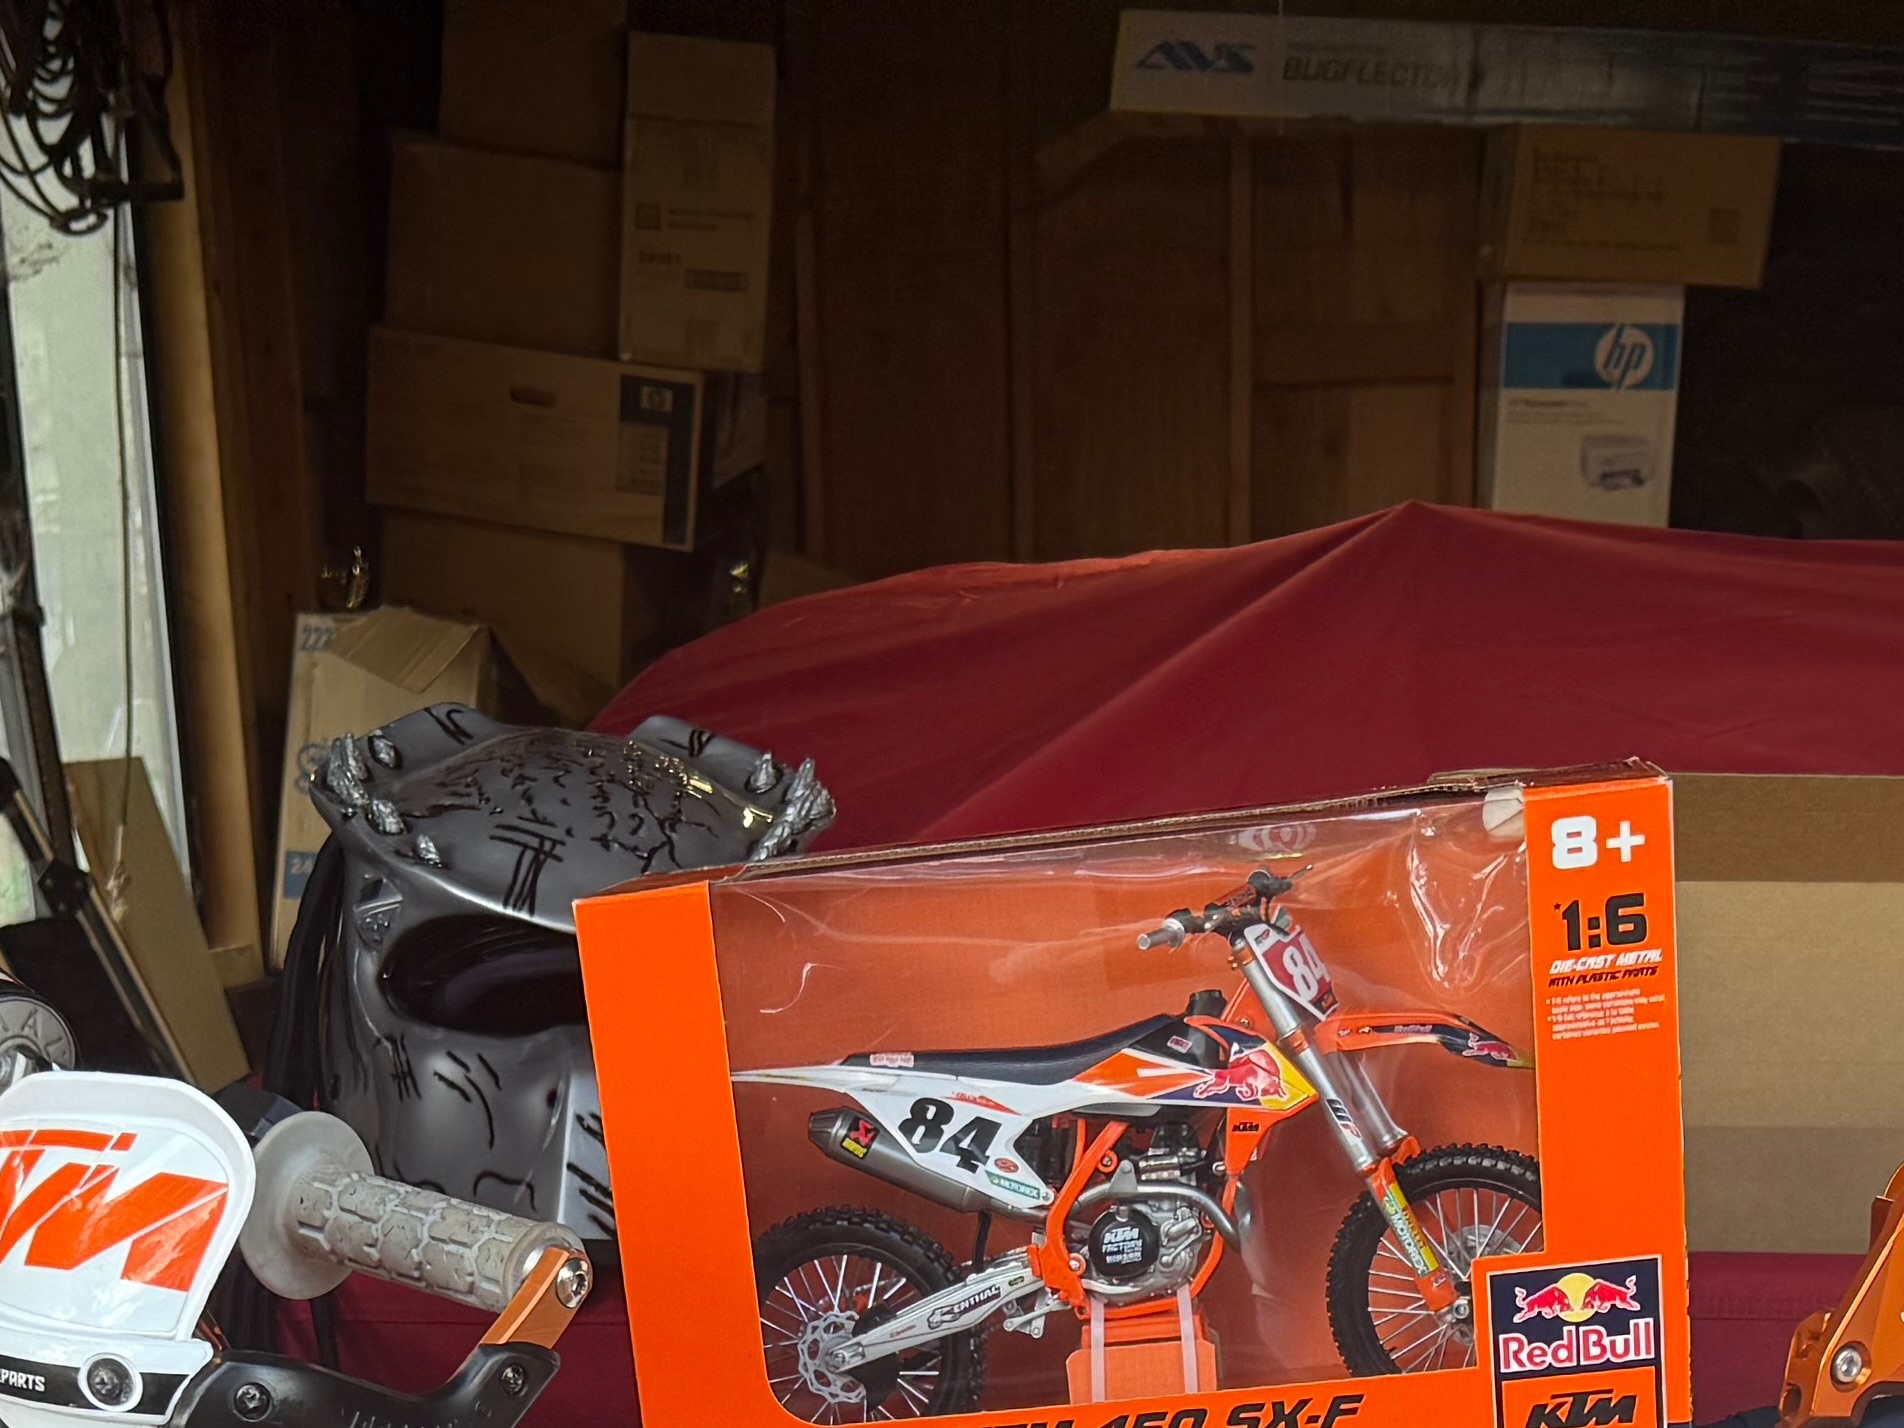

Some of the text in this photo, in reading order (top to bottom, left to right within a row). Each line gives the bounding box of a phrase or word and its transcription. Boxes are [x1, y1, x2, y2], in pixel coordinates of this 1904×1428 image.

[1551, 815, 1646, 870] 8+
[1575, 969, 1622, 986] PLASTIC
[1616, 949, 1663, 967] METAL
[898, 1097, 1003, 1174] 84
[1500, 1319, 1654, 1372] Red Bull
